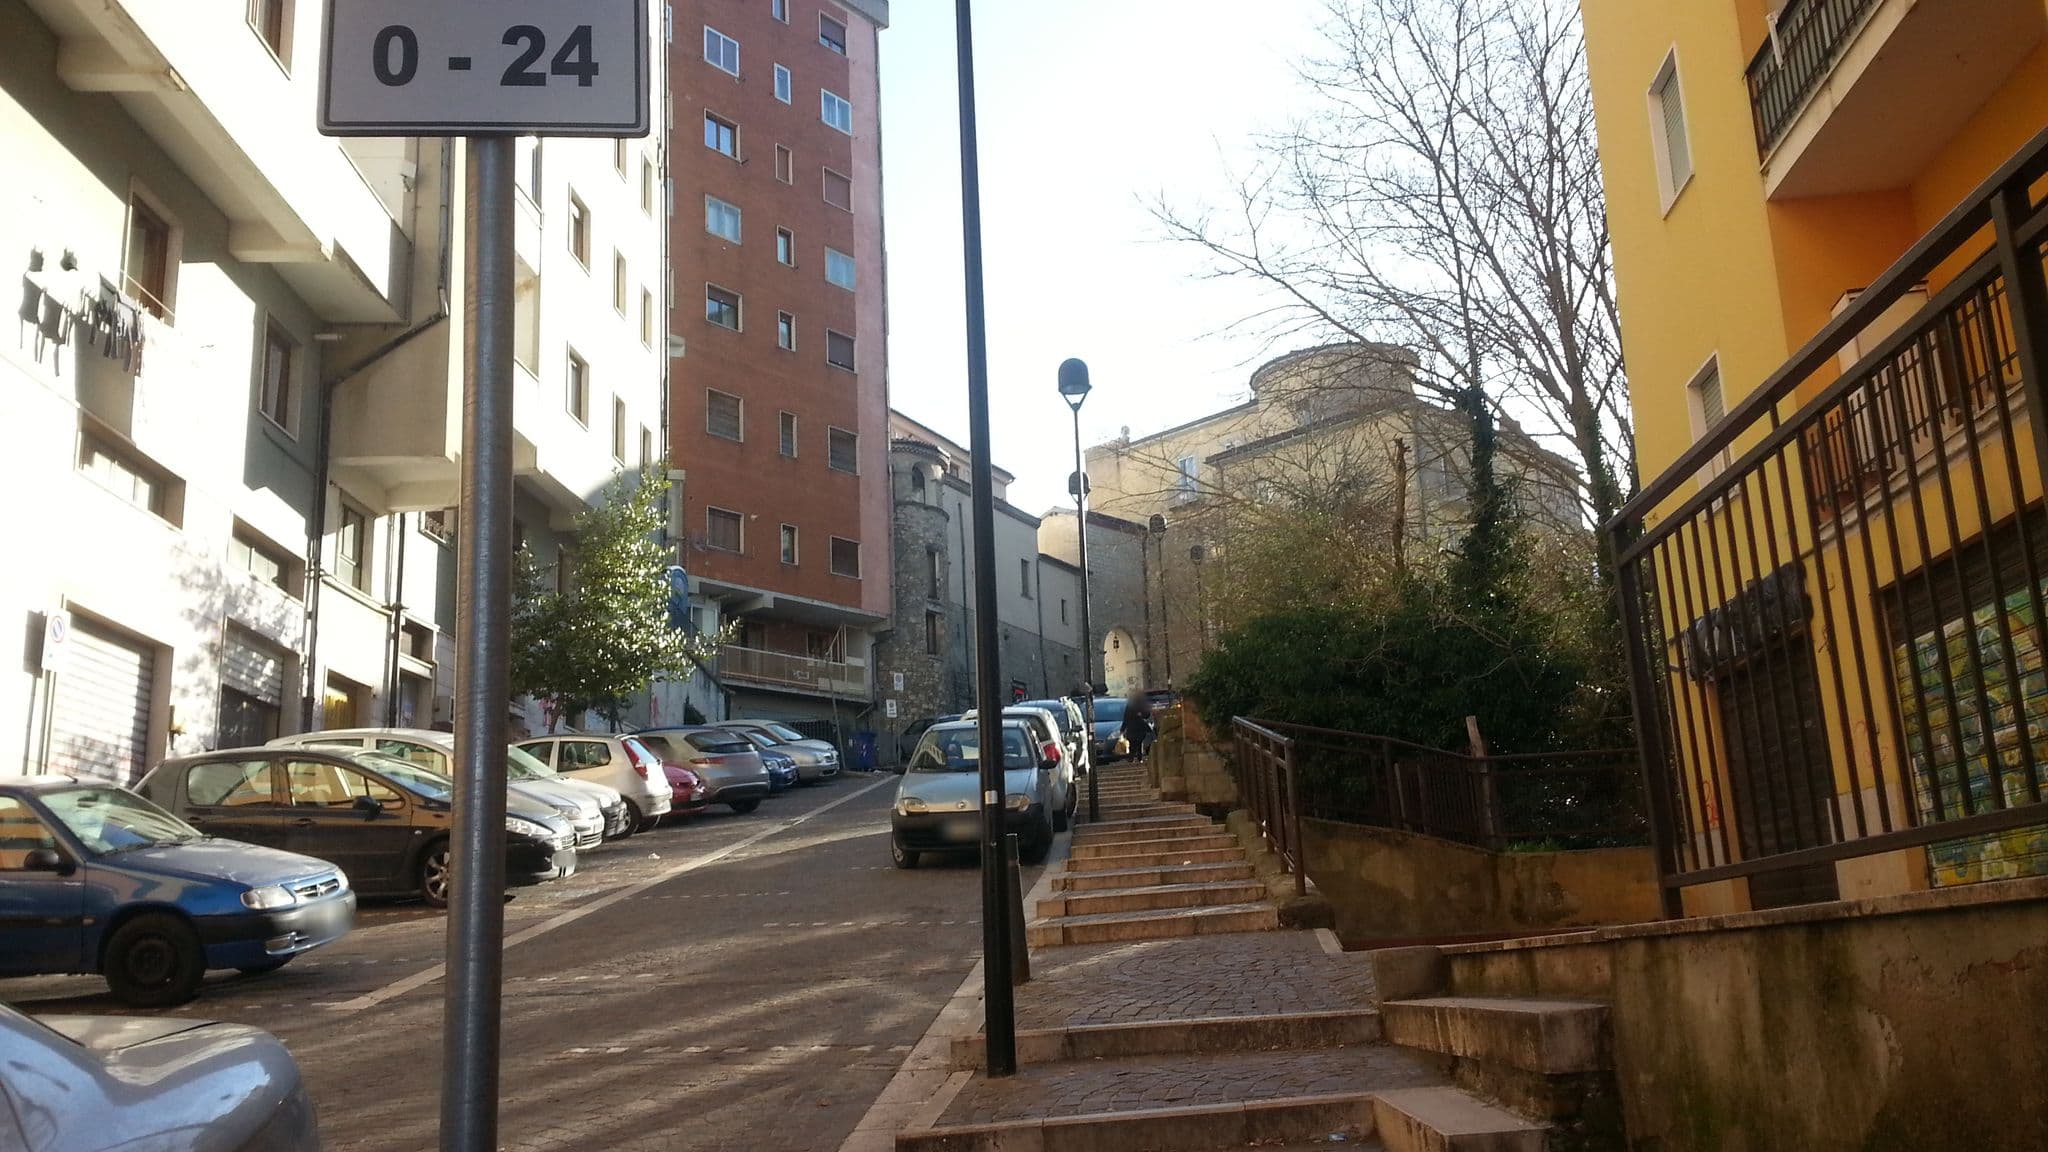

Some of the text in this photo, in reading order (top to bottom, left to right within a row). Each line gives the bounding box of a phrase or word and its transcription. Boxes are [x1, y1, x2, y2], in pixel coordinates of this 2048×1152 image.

[373, 25, 599, 87] 0 - 24
